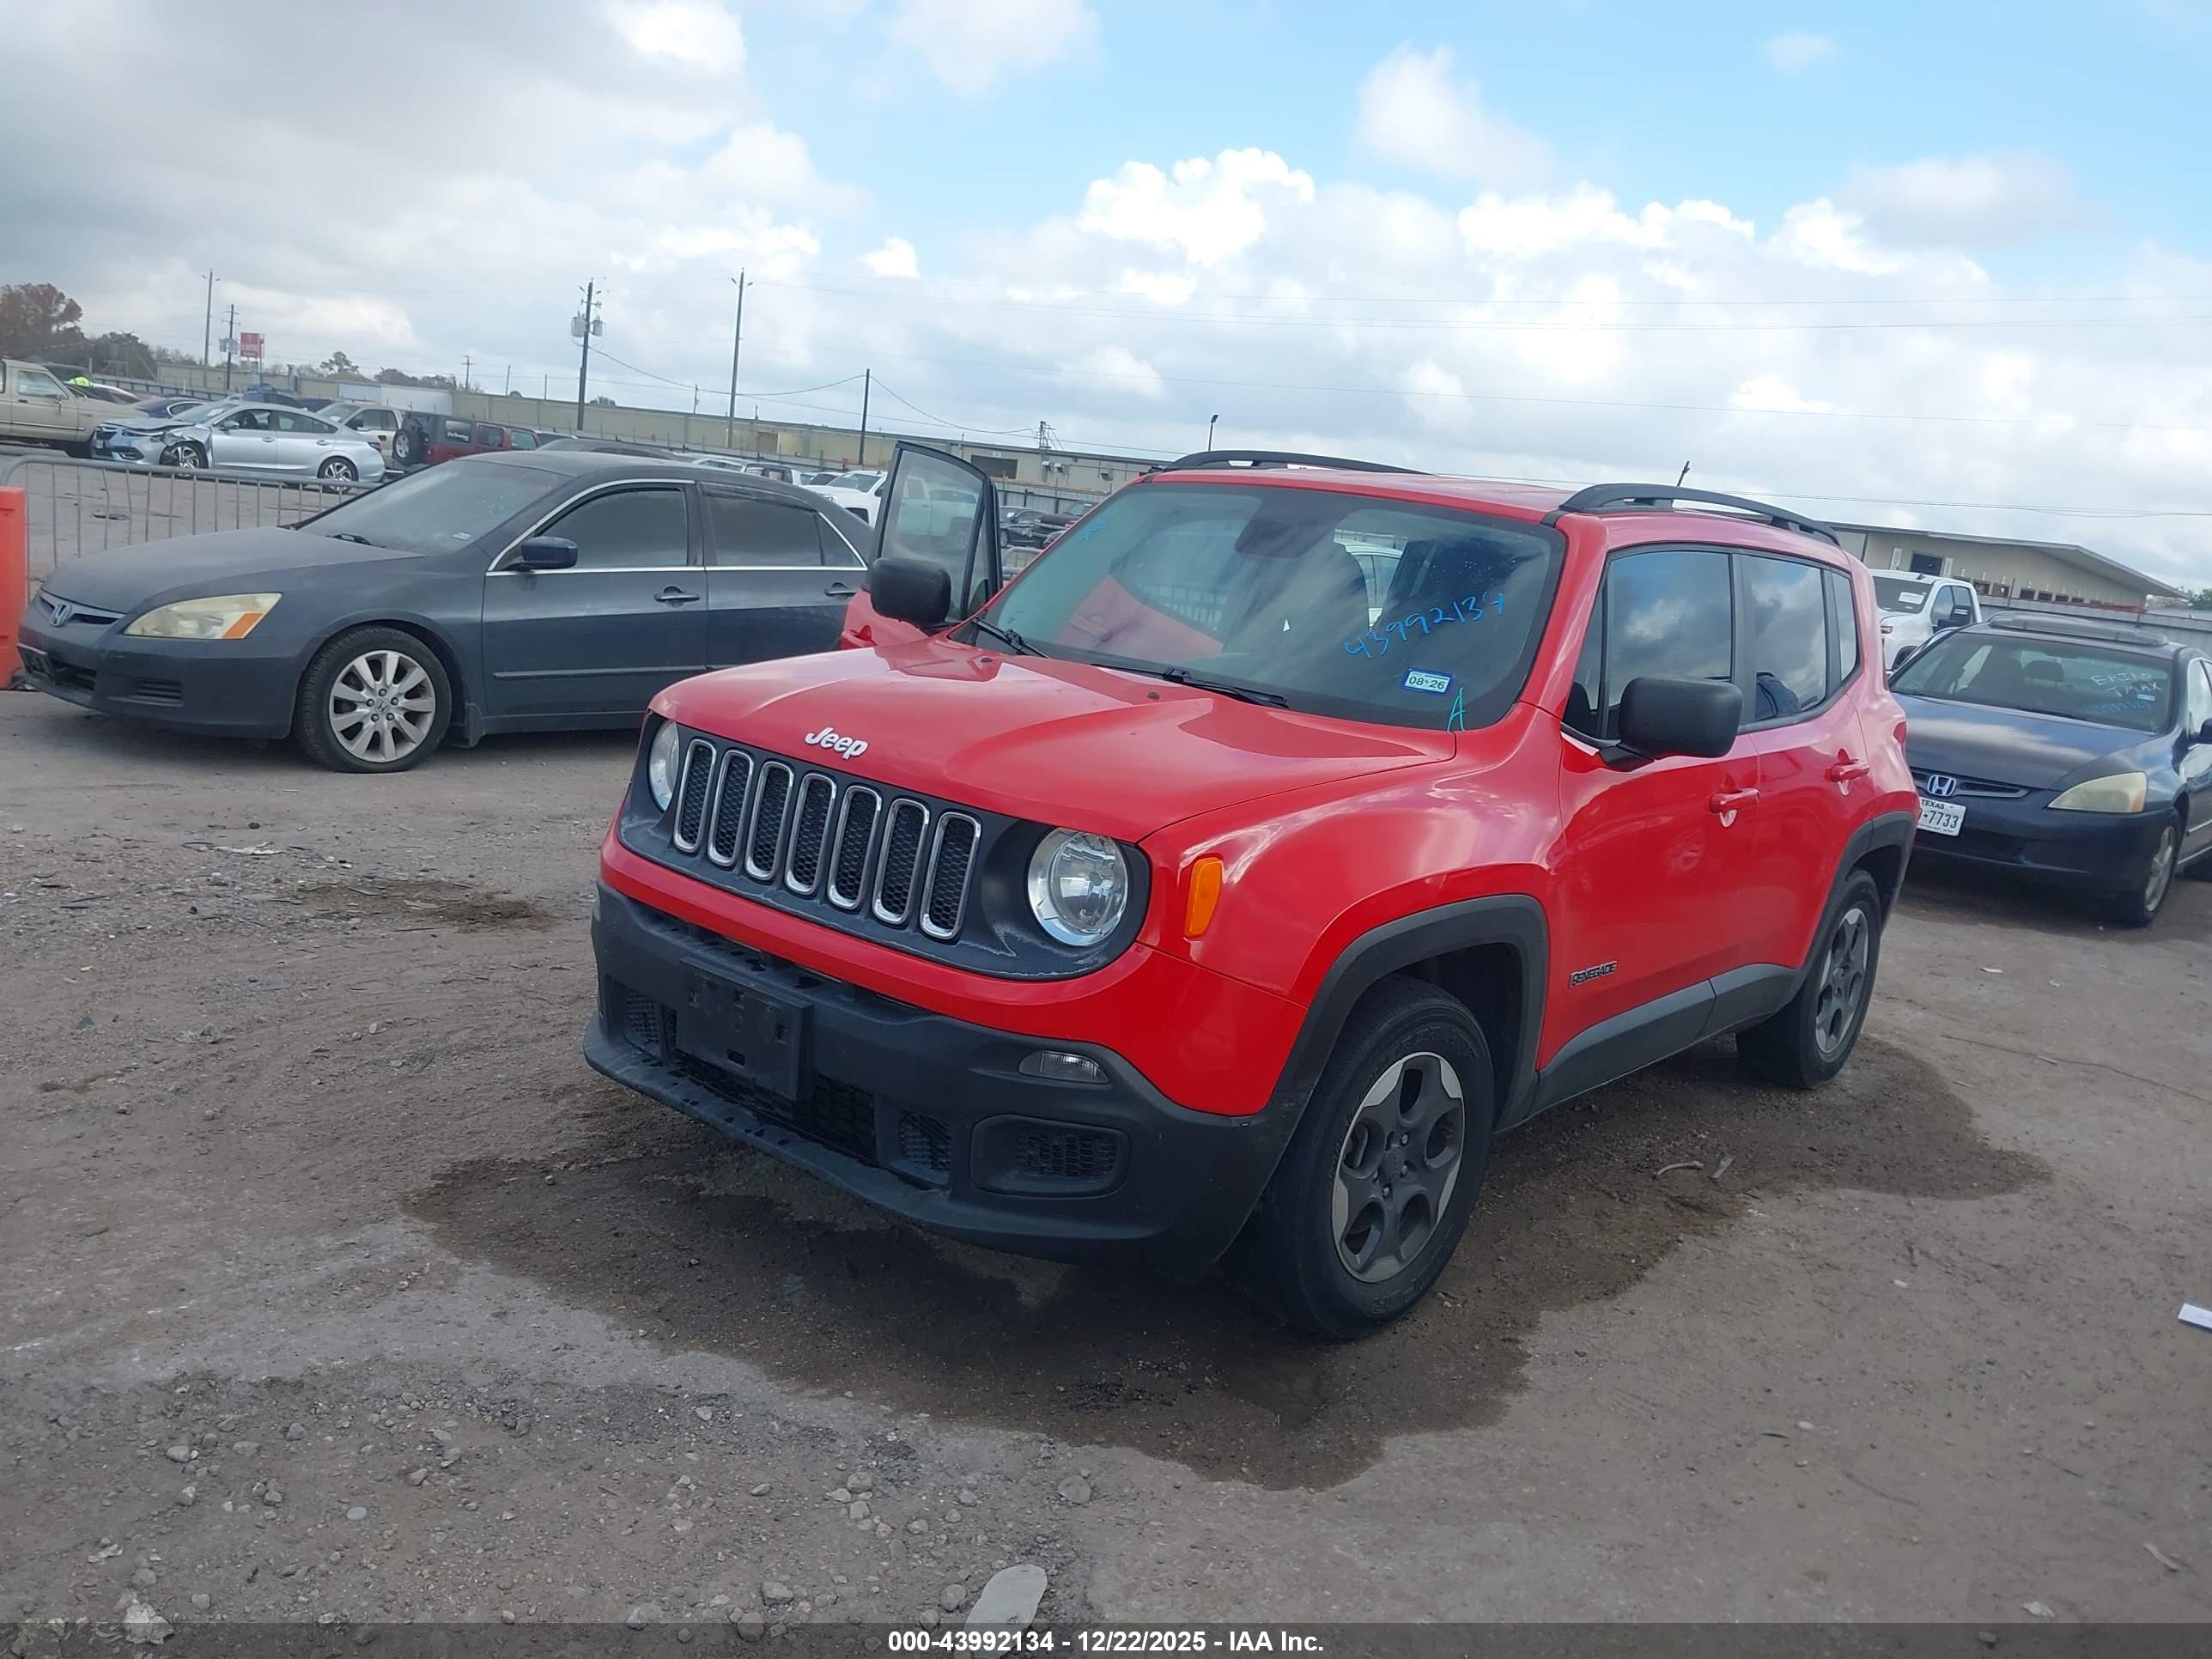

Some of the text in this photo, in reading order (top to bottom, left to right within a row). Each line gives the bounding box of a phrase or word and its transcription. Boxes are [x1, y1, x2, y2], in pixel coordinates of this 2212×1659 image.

[1447, 686, 1467, 732] A
[805, 726, 868, 761] Jeep
[1922, 799, 1946, 810] TEXAS
